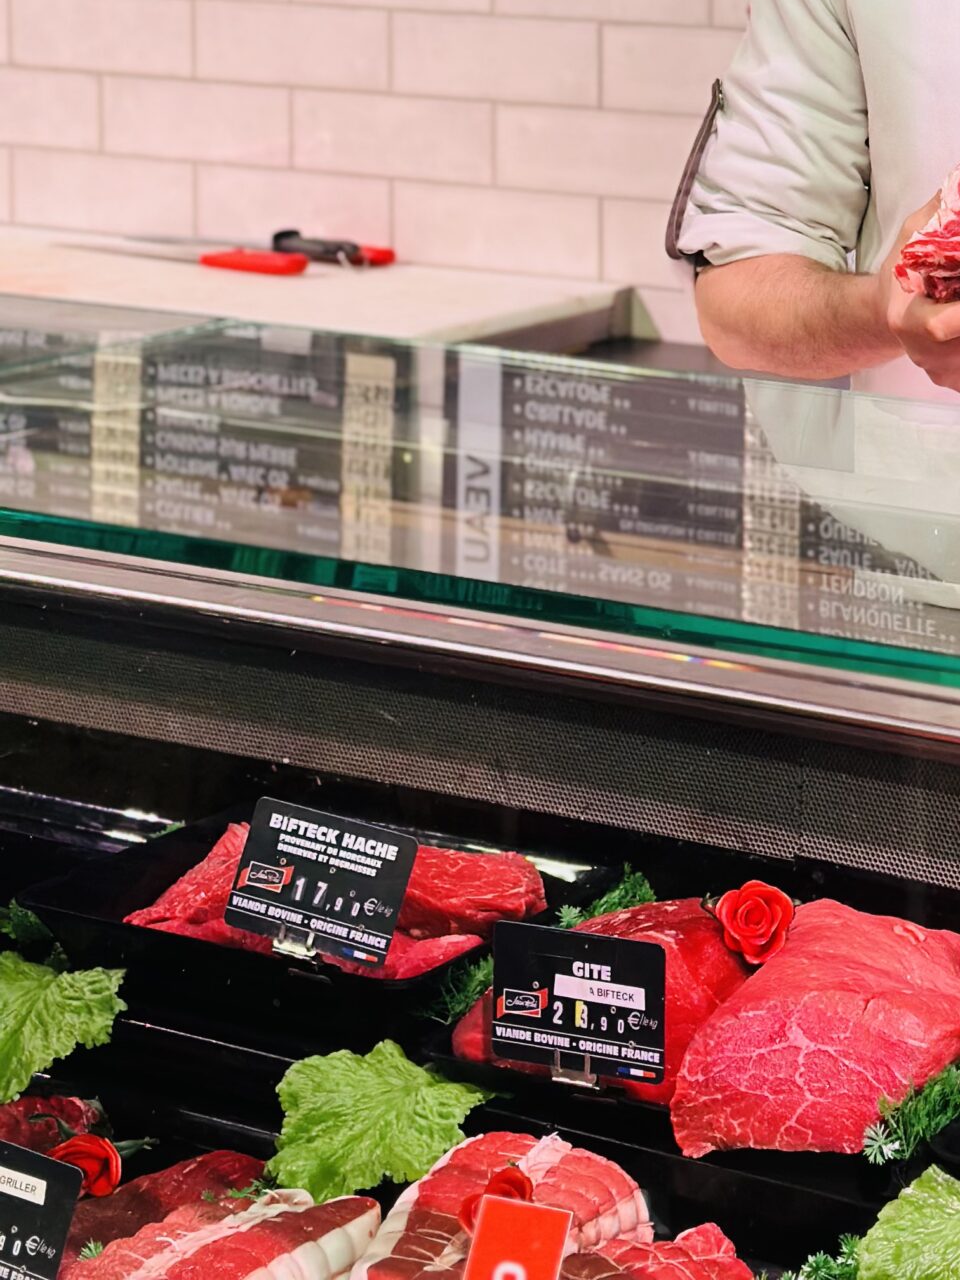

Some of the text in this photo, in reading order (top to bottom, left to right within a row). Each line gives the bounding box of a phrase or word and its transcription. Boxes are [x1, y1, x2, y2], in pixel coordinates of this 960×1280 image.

[269, 813, 399, 861] BIFTECK HACHE
[278, 833, 383, 869] PROVENANT DE MORCEAUX
[276, 842, 377, 877] DENERVES ET DEGRAISSES
[231, 895, 387, 949] VIANDE BOVINE ORIGINE FRANCE
[572, 961, 612, 981] GITE
[596, 986, 635, 1003] BIFTECK
[495, 1026, 660, 1064] VIANDE BOVINE ORIGINE FRANCE
[0, 1175, 37, 1194] GRILLER
